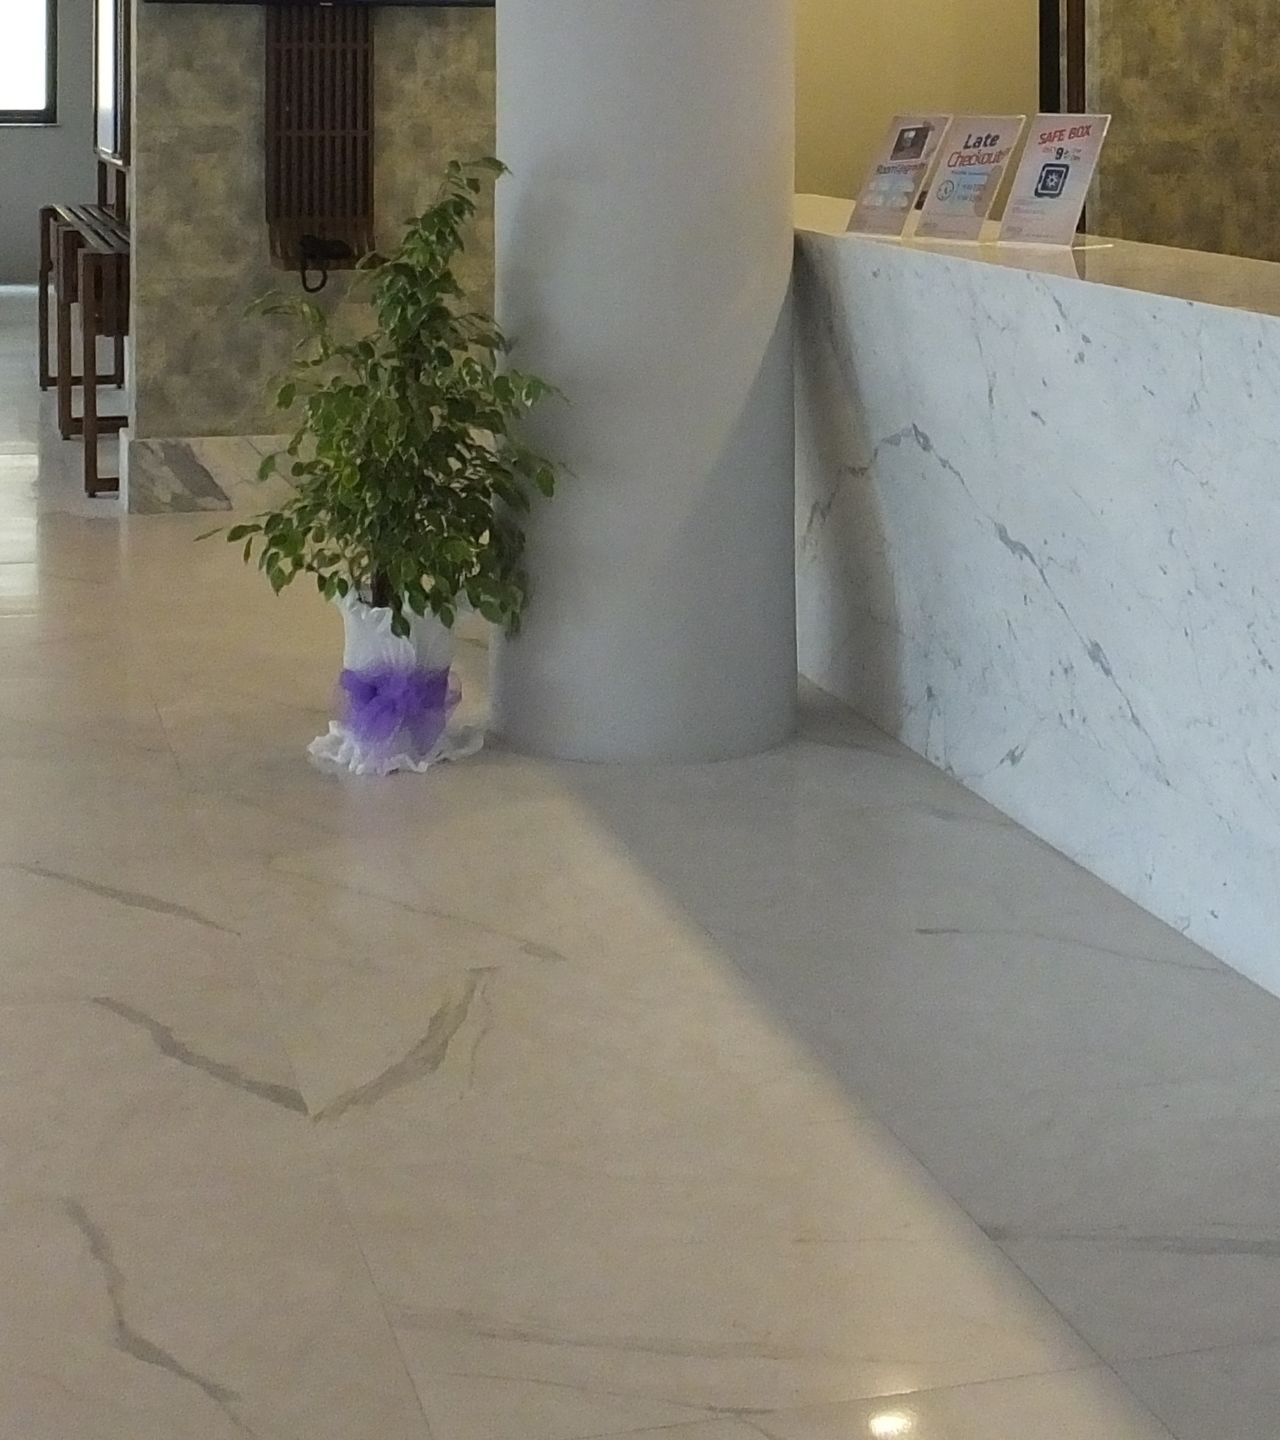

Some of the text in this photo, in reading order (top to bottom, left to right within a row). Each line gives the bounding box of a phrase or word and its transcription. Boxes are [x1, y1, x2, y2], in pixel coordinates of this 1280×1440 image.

[963, 133, 1000, 149] Late
[1038, 125, 1092, 145] SAFE BOX
